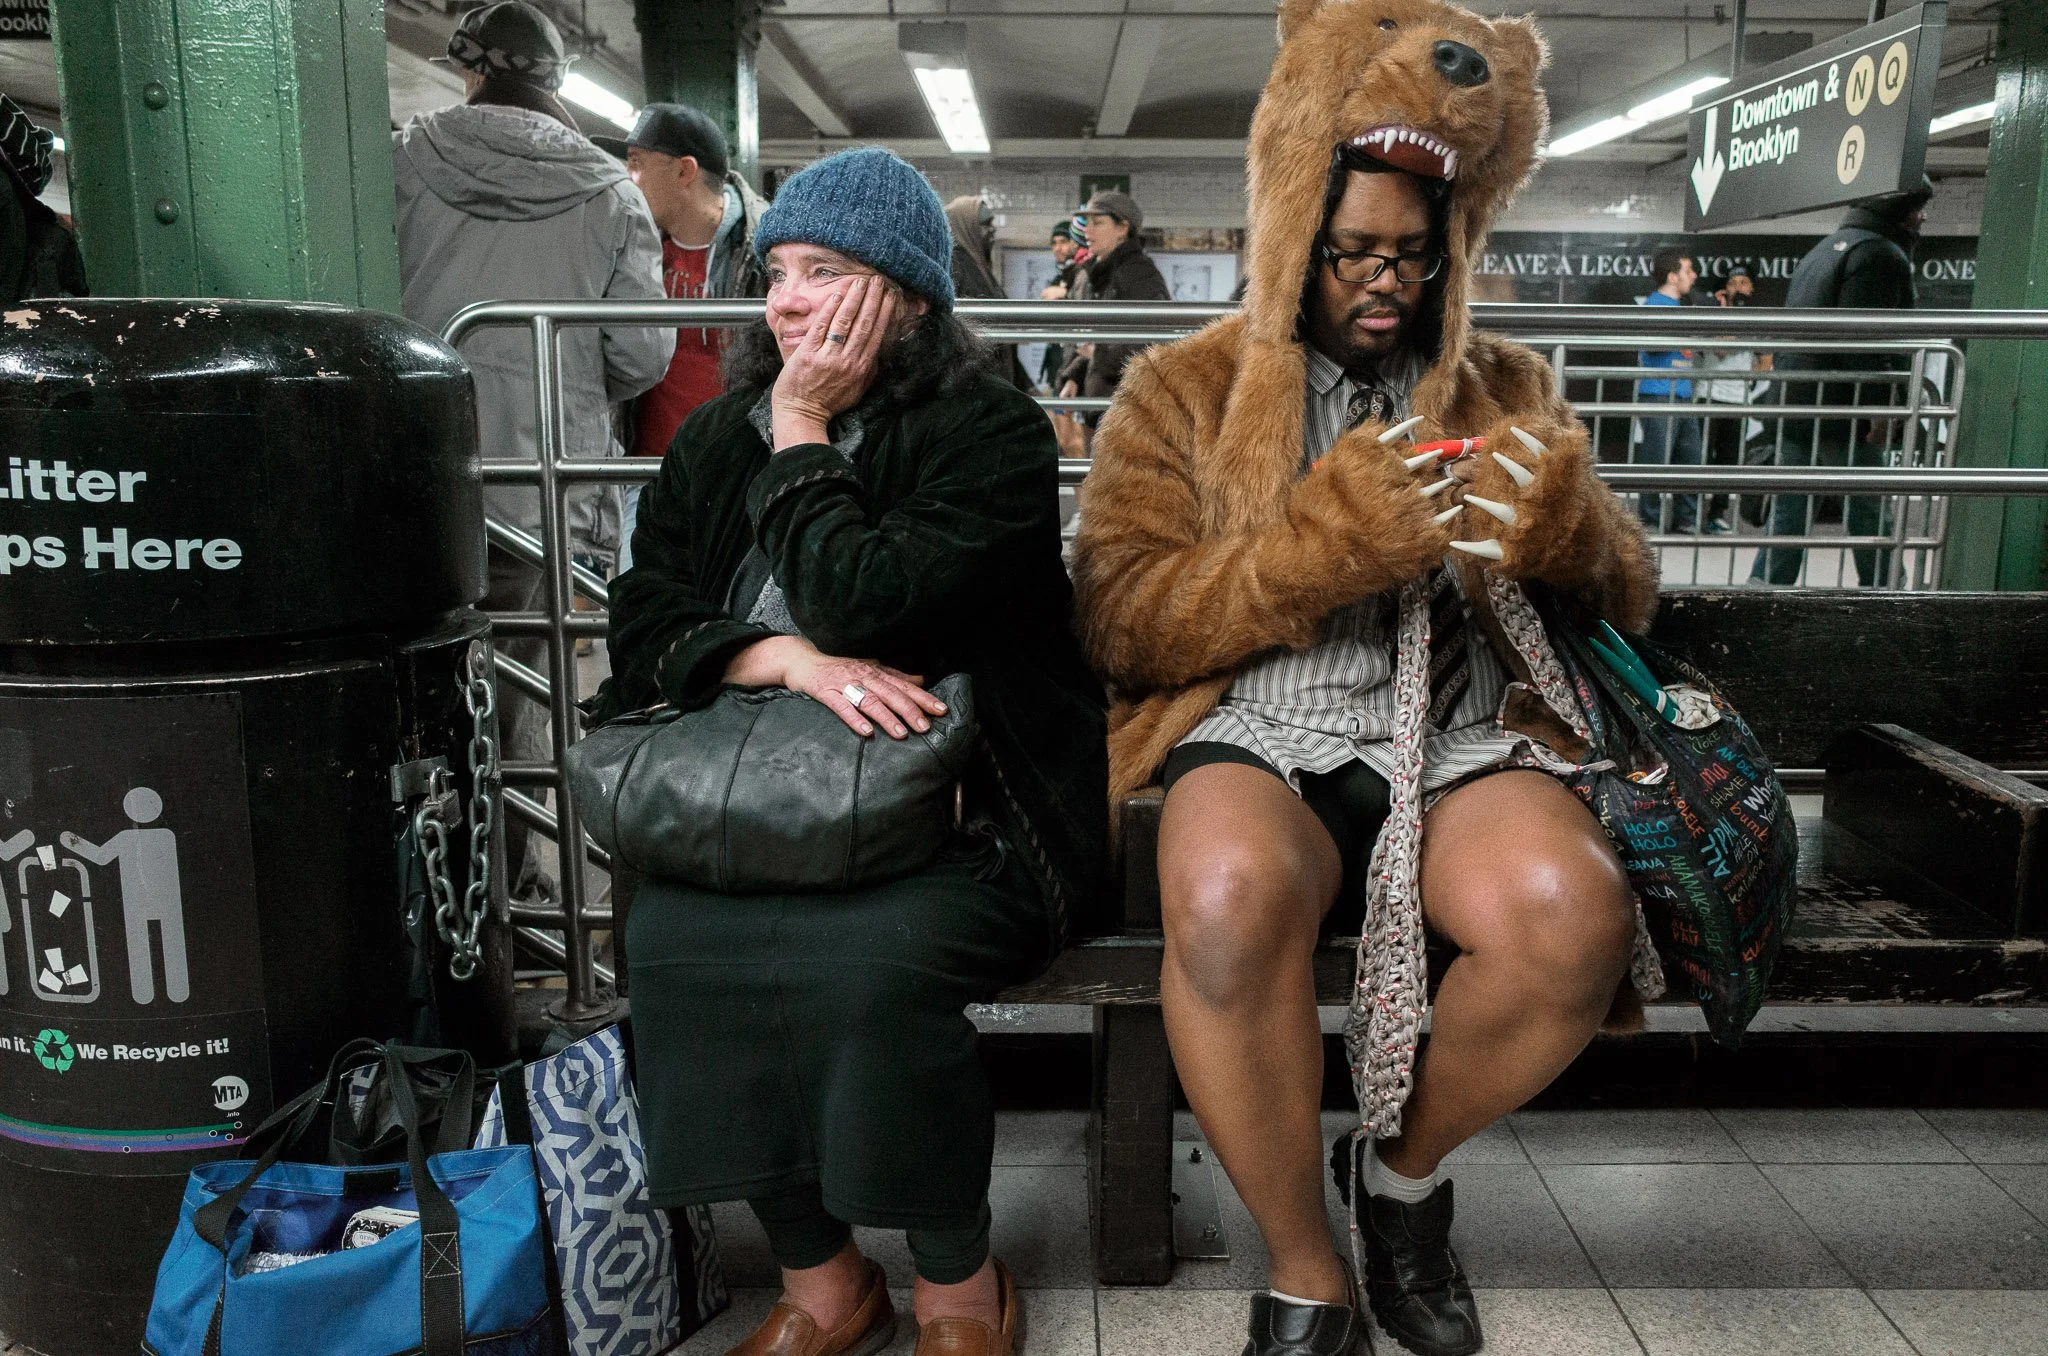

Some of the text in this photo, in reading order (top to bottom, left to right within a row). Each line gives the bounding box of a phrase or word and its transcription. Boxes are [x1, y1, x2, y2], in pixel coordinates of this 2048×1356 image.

[1852, 69, 1868, 102] N
[1885, 56, 1900, 91] Q
[1731, 63, 1840, 133] Downtown &
[1728, 124, 1799, 171] Brooklyn
[1844, 140, 1858, 170] R
[1554, 254, 1572, 275] A
[1580, 255, 1655, 277] LEGA
[1697, 256, 1751, 278] YO
[1922, 259, 1977, 280] ONE
[82, 527, 242, 570] Here
[1710, 775, 1747, 808] SHAME
[1623, 820, 1670, 836] HOLO
[1630, 835, 1678, 851] HOLO
[14, 1036, 31, 1053] it.
[76, 1037, 230, 1062] We Recycle it!
[213, 1085, 243, 1105] MTA
